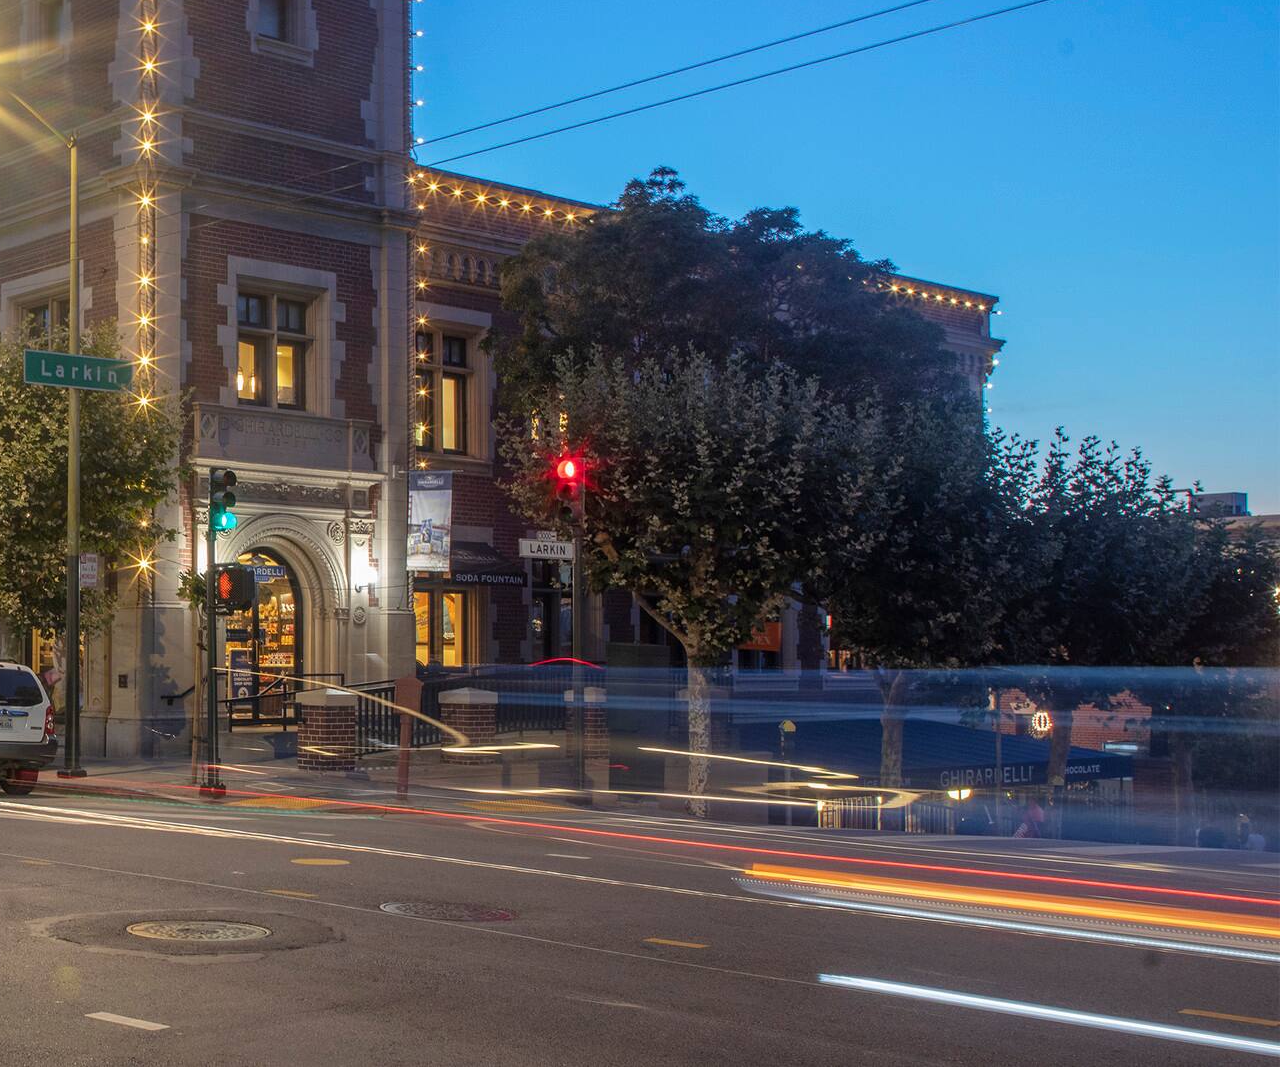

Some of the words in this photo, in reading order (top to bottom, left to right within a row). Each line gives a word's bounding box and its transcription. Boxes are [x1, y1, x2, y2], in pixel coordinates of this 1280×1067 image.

[40, 359, 118, 383] Larkin
[529, 544, 566, 555] LARKIN
[456, 574, 479, 582] SODA
[481, 574, 524, 584] FOUNTAIN
[1064, 764, 1101, 775] HOCOLATE
